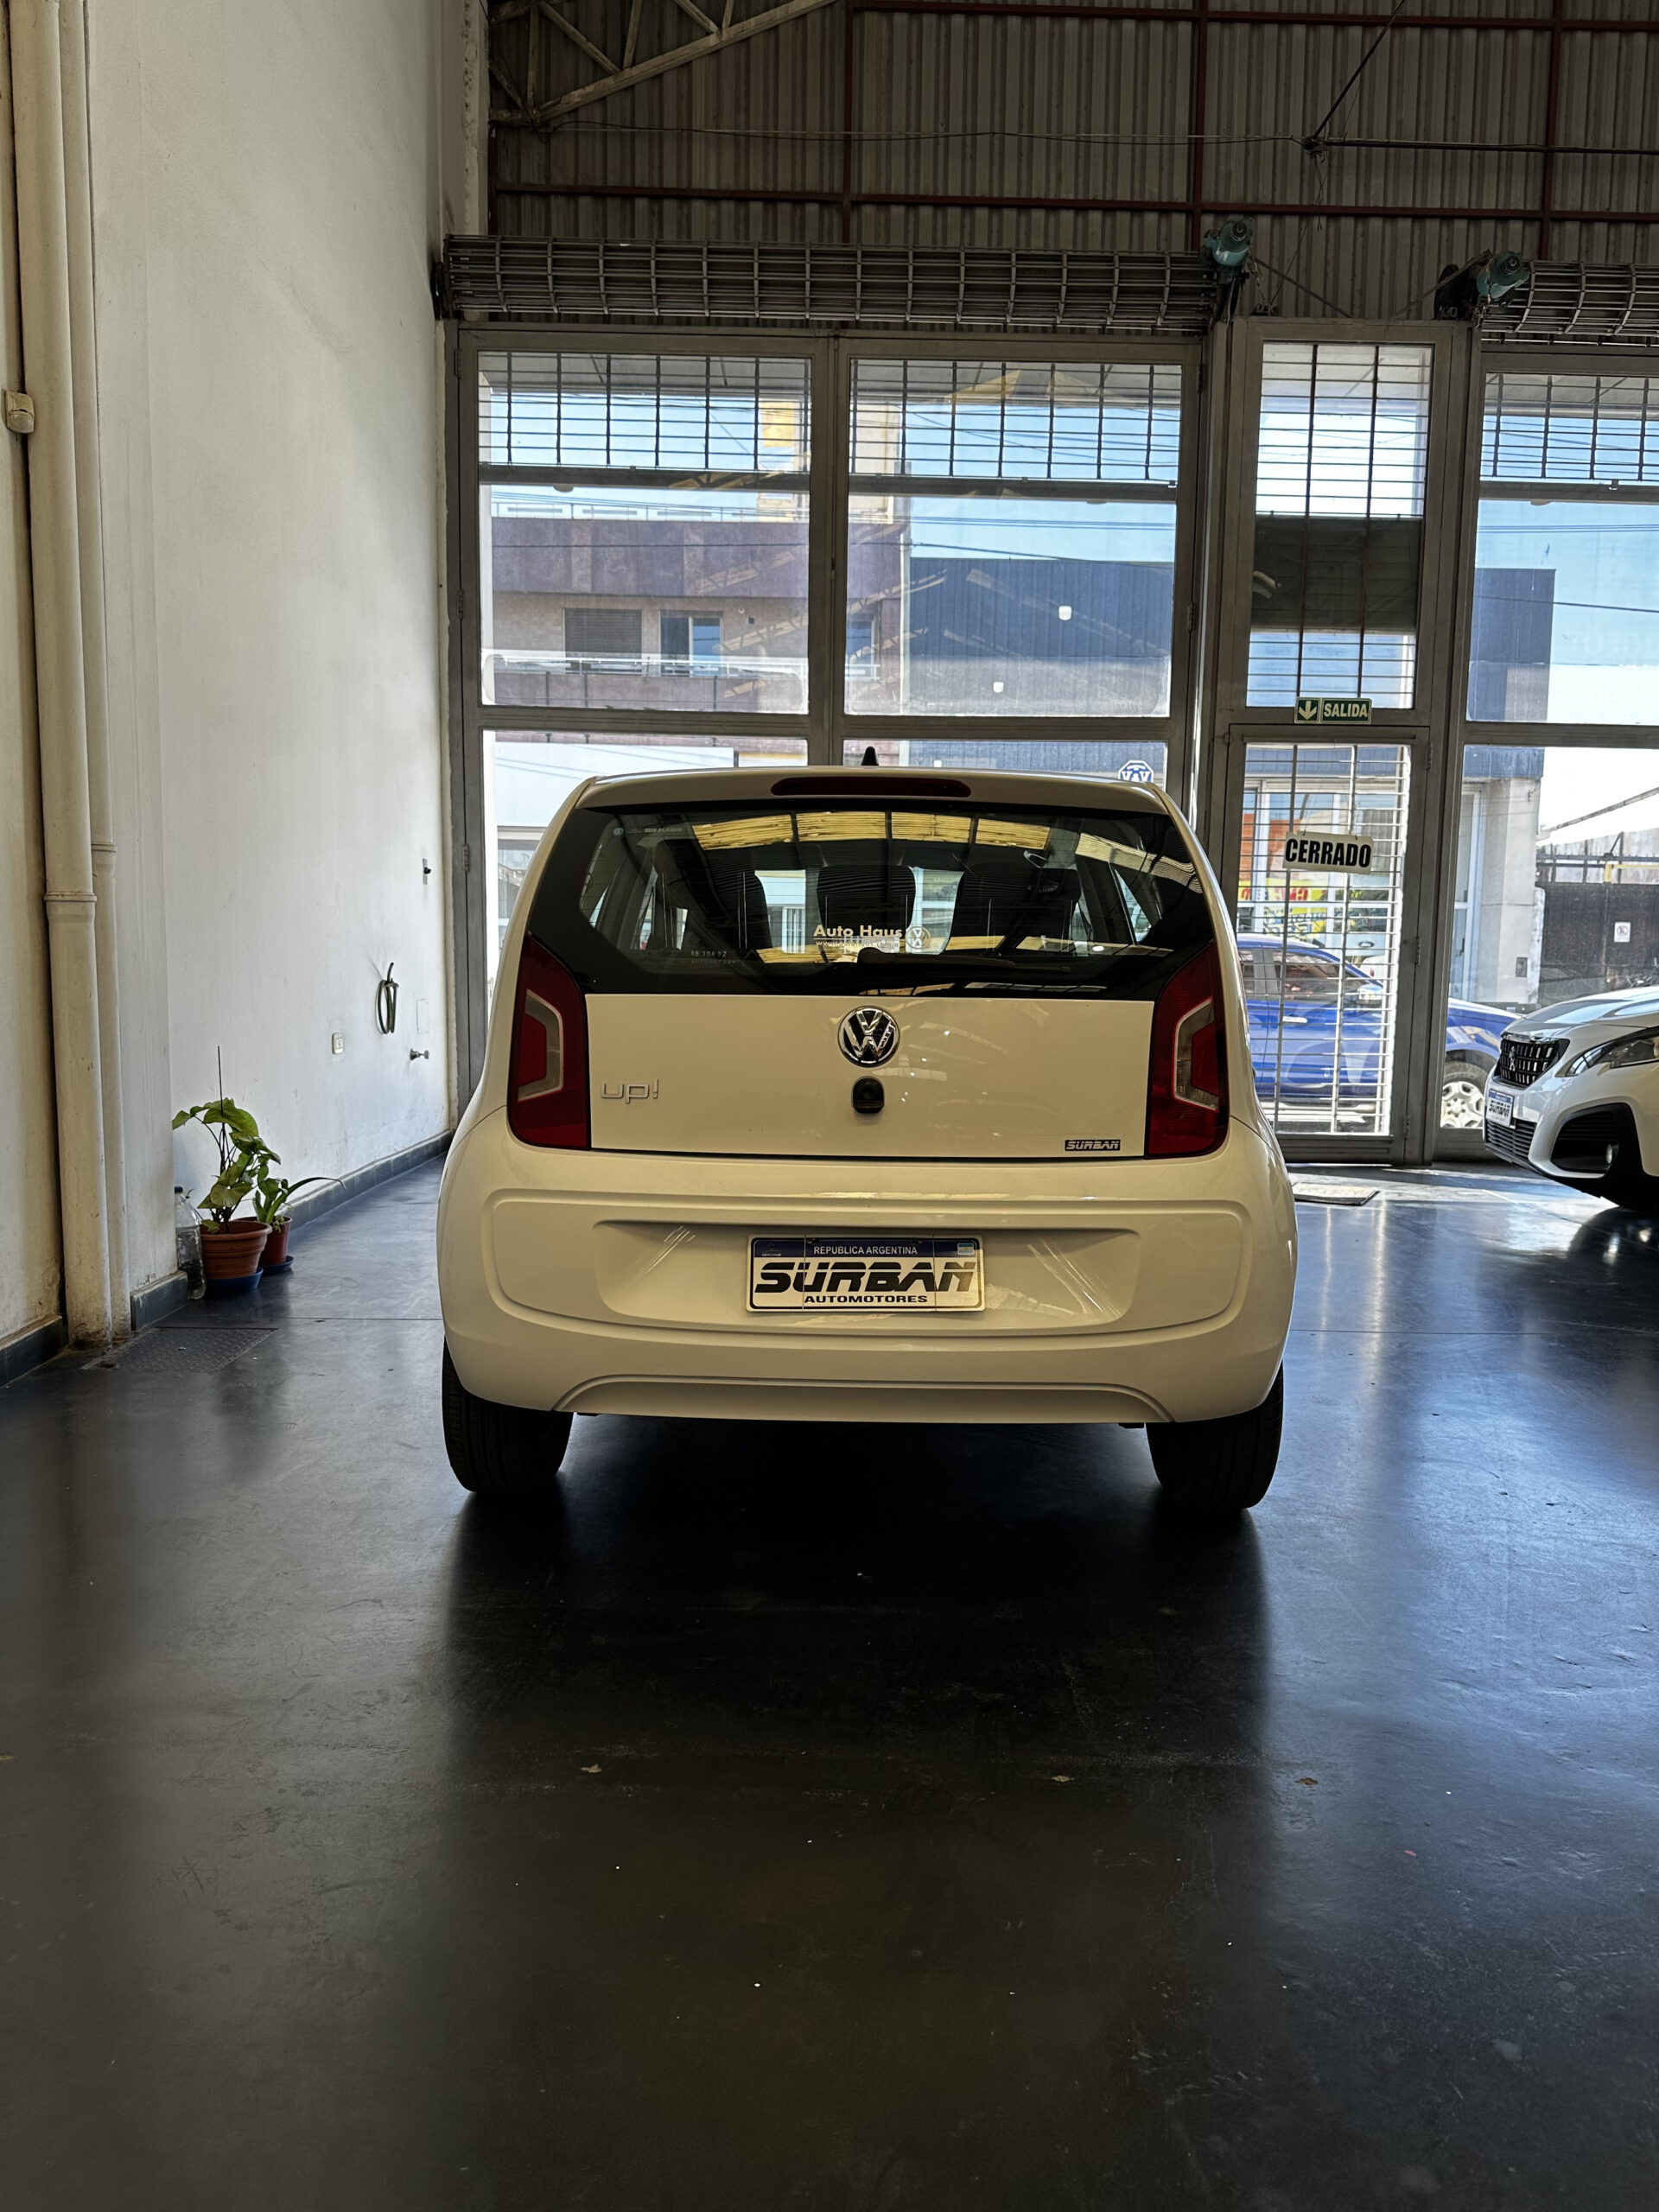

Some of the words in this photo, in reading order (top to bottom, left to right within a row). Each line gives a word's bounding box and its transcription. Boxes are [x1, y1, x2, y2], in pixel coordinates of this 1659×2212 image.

[1324, 702, 1368, 718] SALIDA
[1285, 838, 1372, 868] CERRADO
[813, 925, 854, 938] Auto
[860, 925, 903, 938] Haus
[601, 1078, 658, 1104] up!
[1065, 1141, 1120, 1150] SURBAN
[813, 1246, 864, 1255] REPUBLICA
[866, 1246, 918, 1255] ARGENTINA
[754, 1262, 976, 1293] SURBAN
